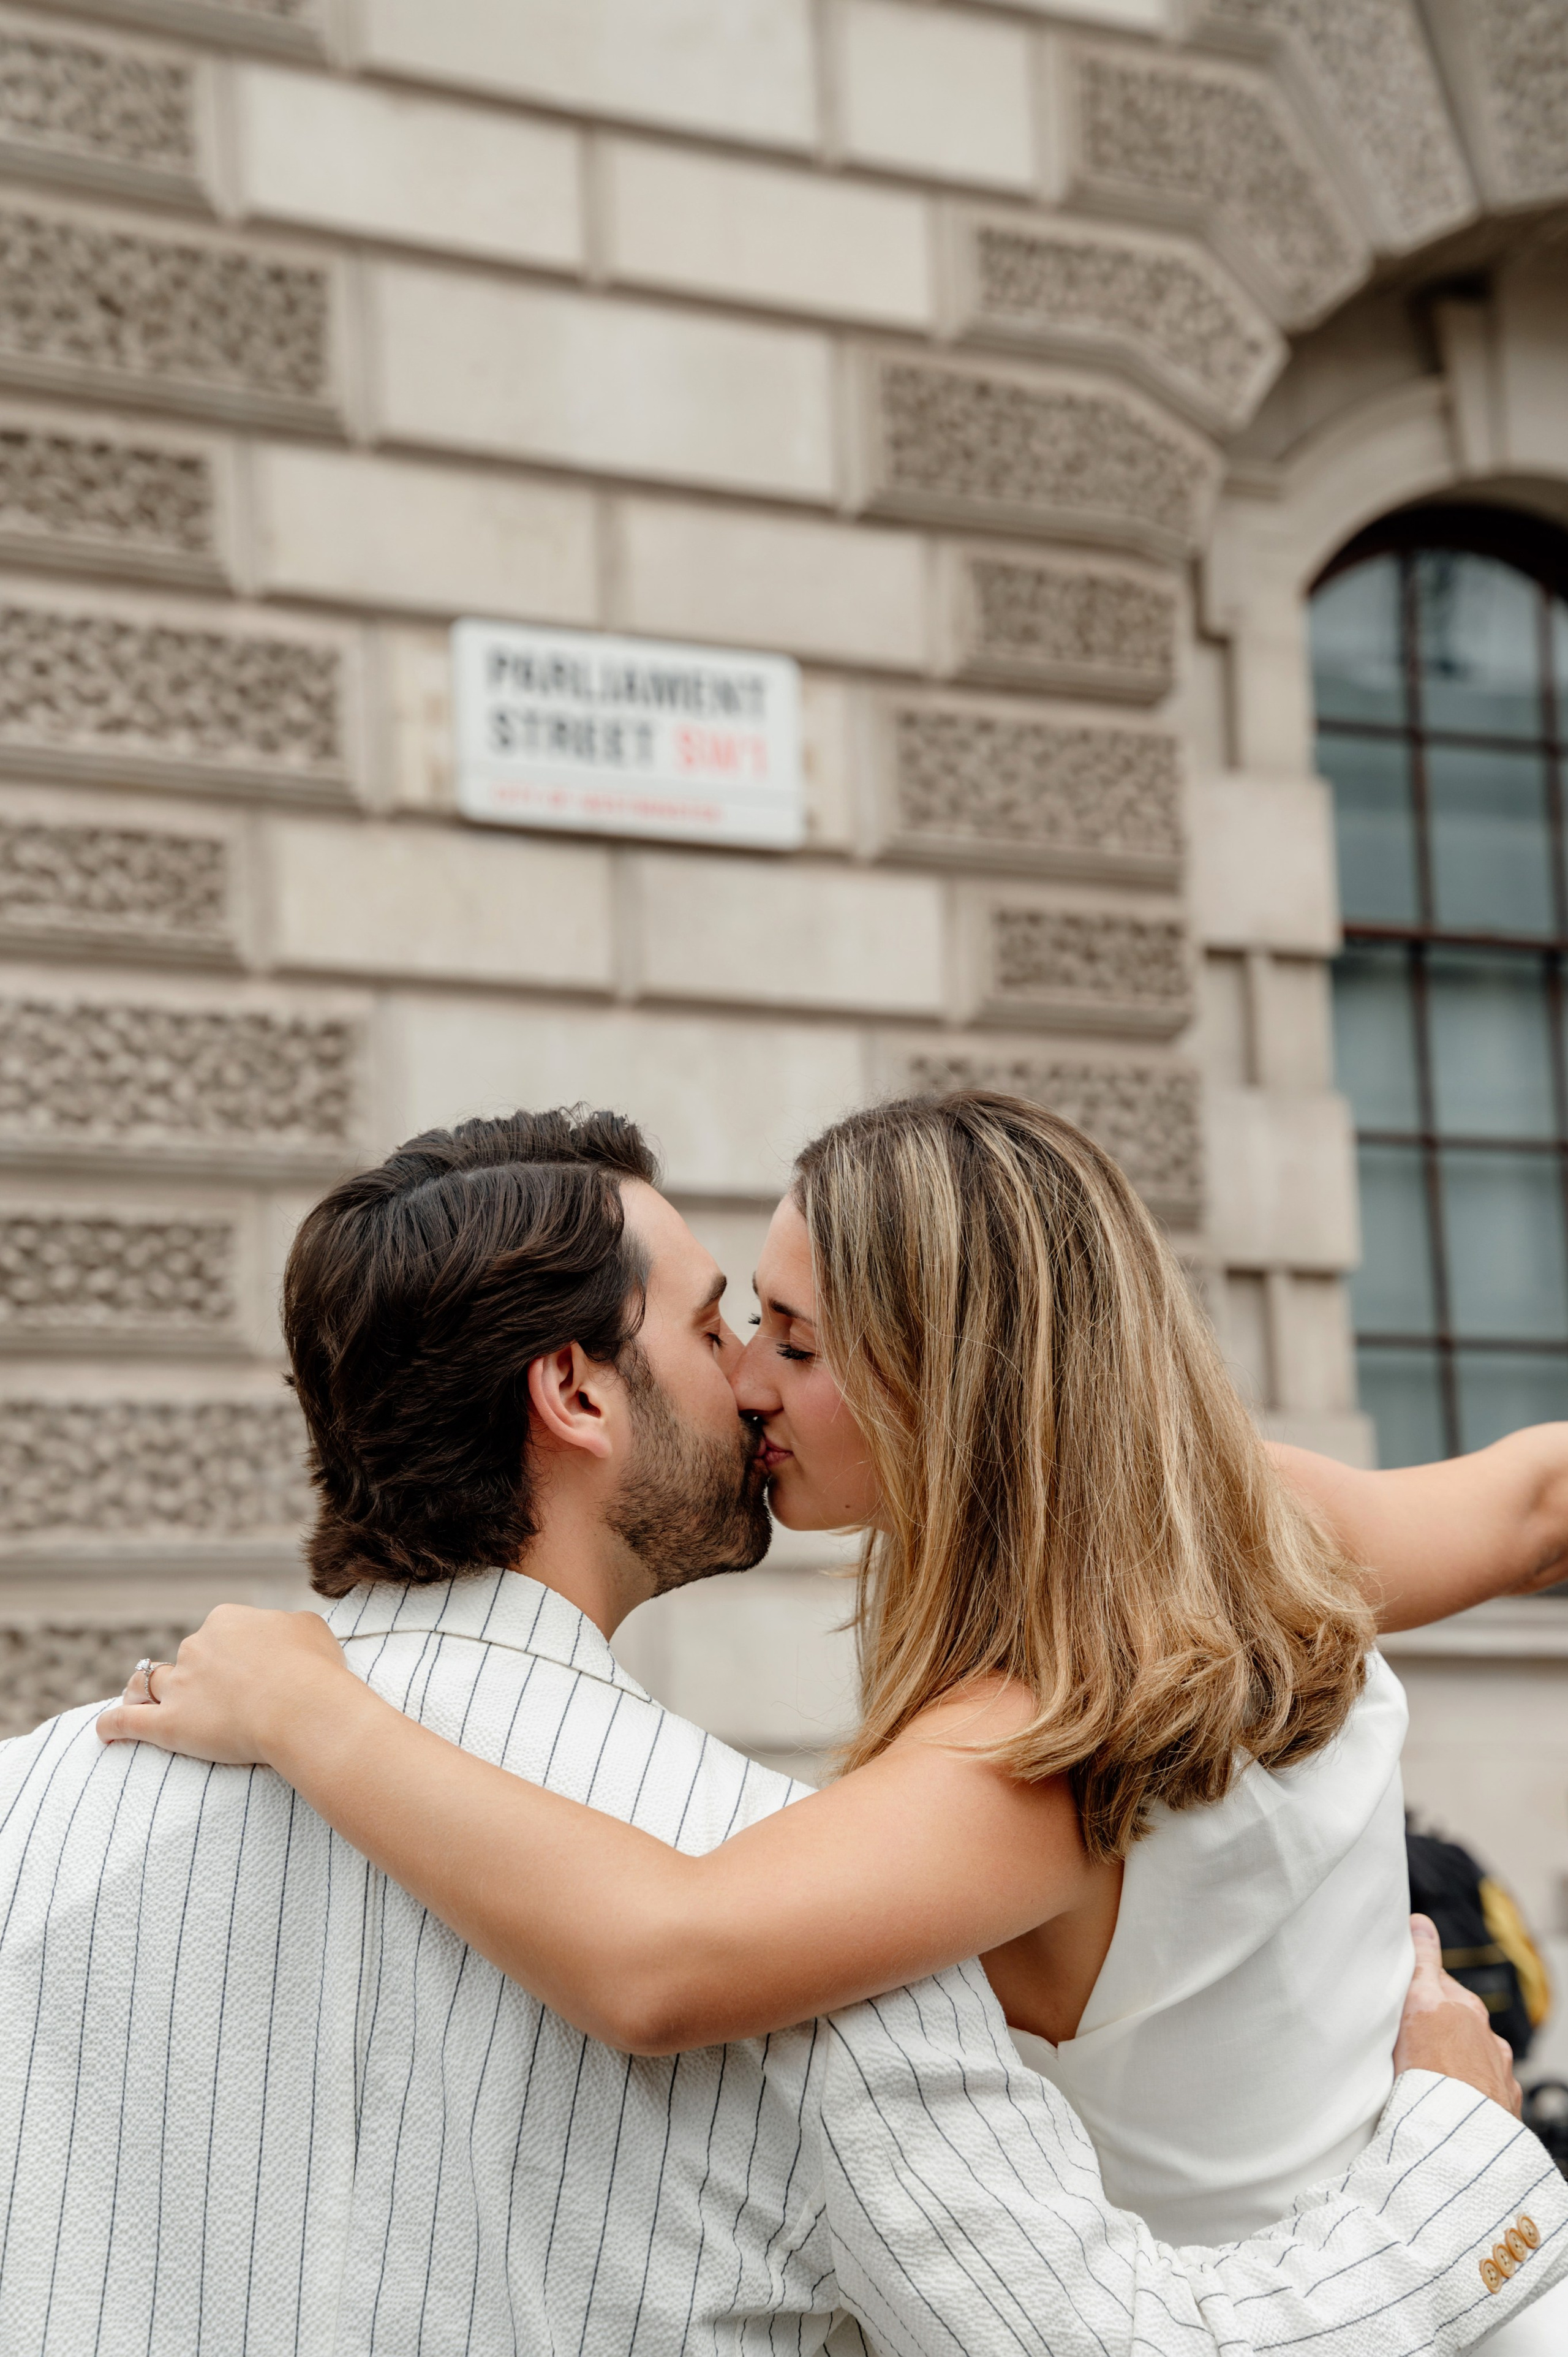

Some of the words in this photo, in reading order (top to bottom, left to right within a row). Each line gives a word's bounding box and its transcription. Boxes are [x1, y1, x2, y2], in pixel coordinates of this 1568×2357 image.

[490, 648, 767, 722] PARLIAMENT
[491, 708, 654, 767] STREET
[676, 724, 767, 782] SW1
